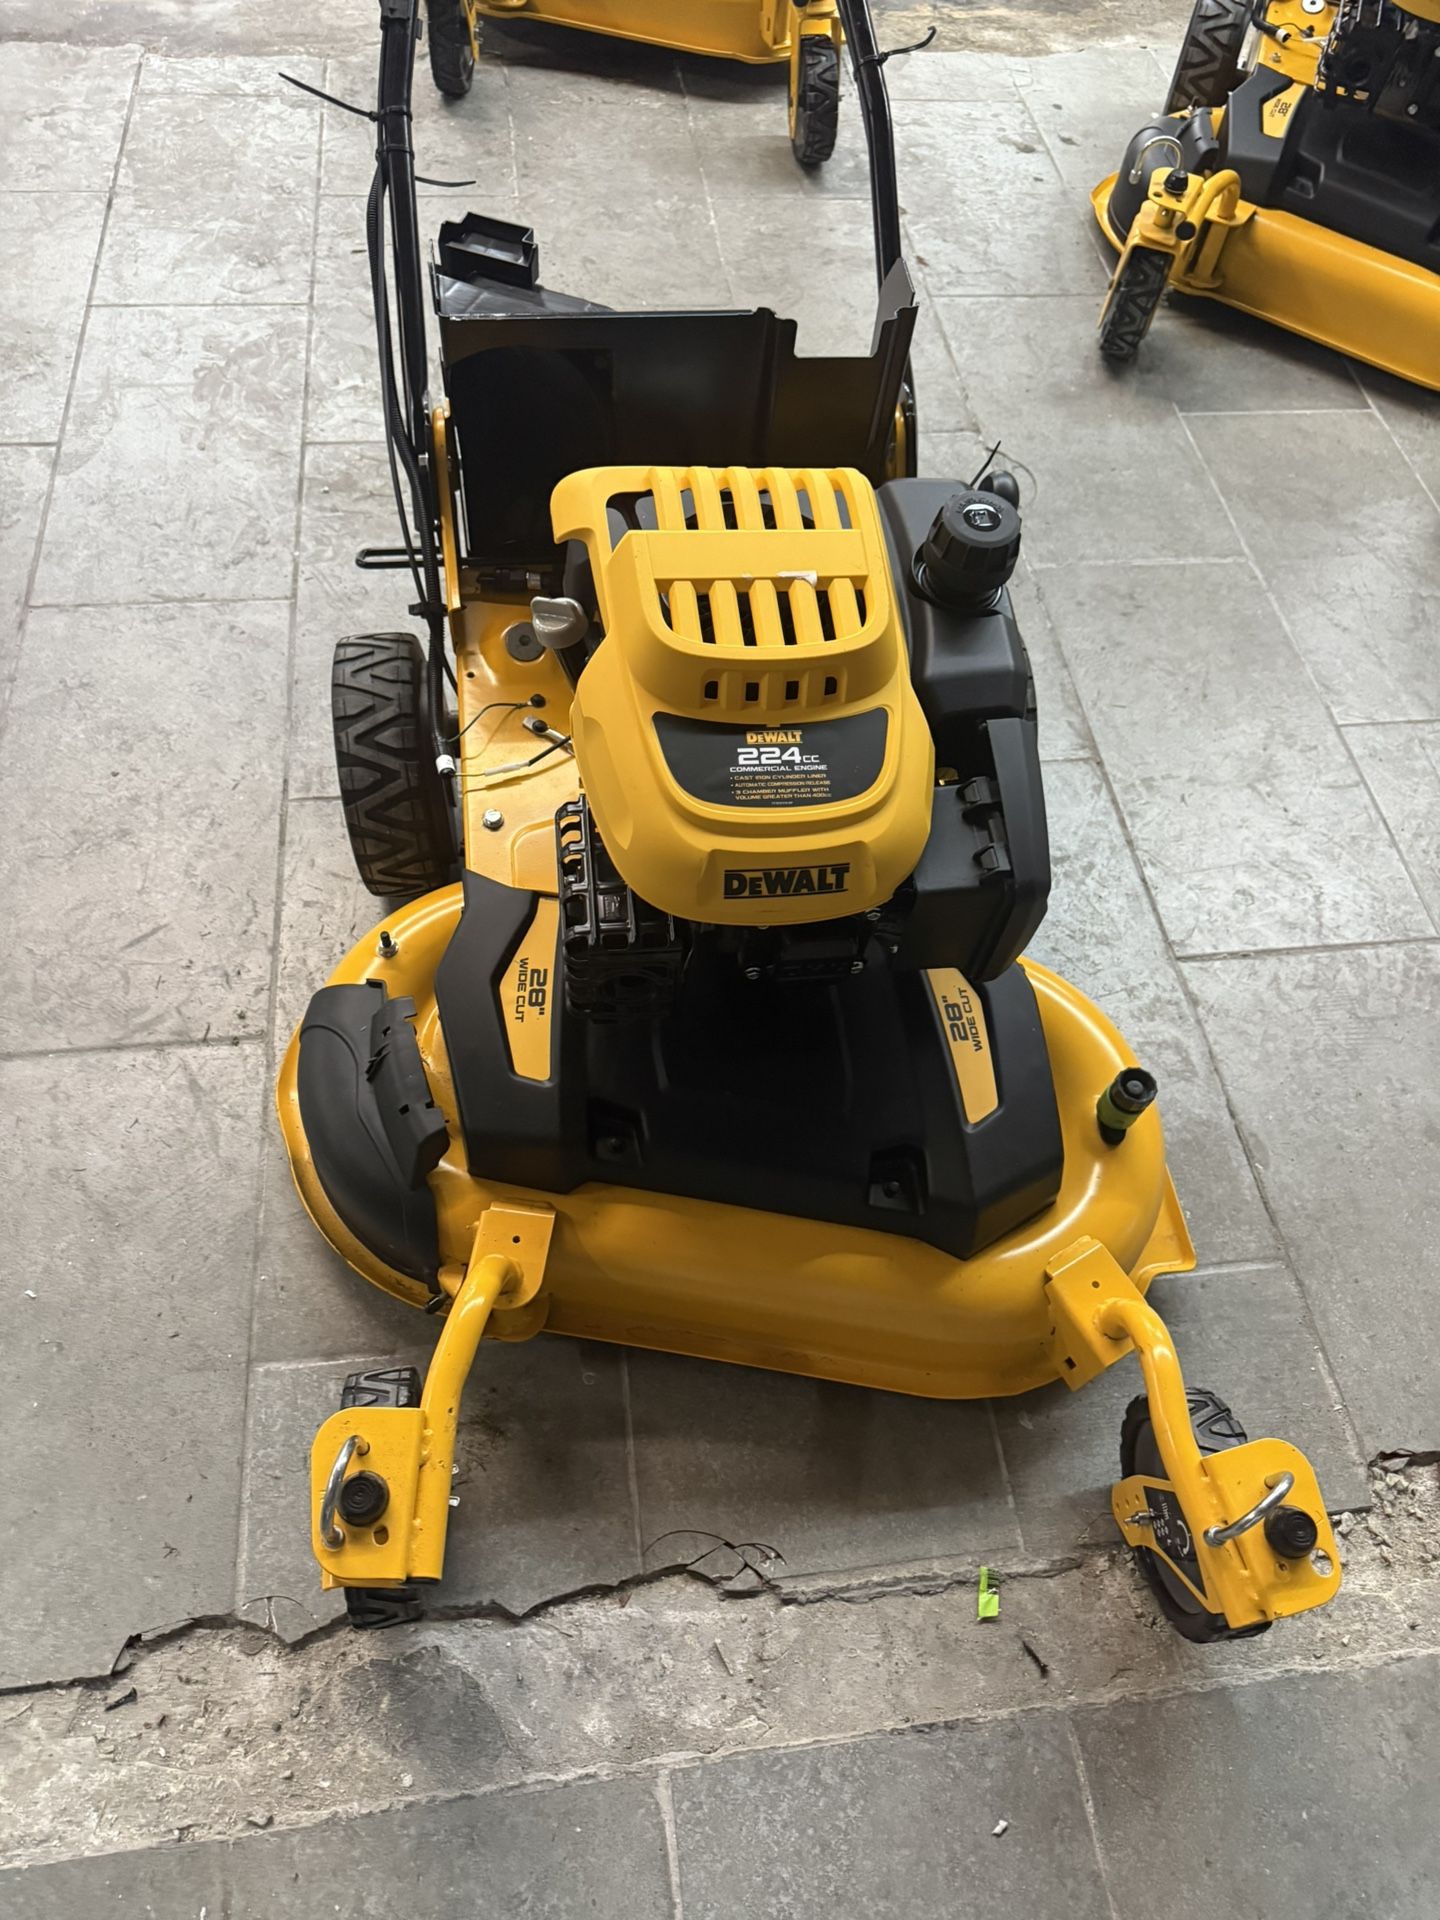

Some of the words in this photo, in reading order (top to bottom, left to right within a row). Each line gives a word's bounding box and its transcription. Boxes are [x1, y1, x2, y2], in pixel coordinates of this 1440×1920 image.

[746, 731, 803, 744] DEWALT
[724, 866, 849, 897] DEWALT
[517, 957, 529, 992] WIDE
[528, 968, 548, 1015] 28"
[957, 987, 972, 1013] CUT
[515, 996, 526, 1022] CUT
[941, 995, 970, 1042] 28"
[966, 1016, 983, 1052] WIDE
